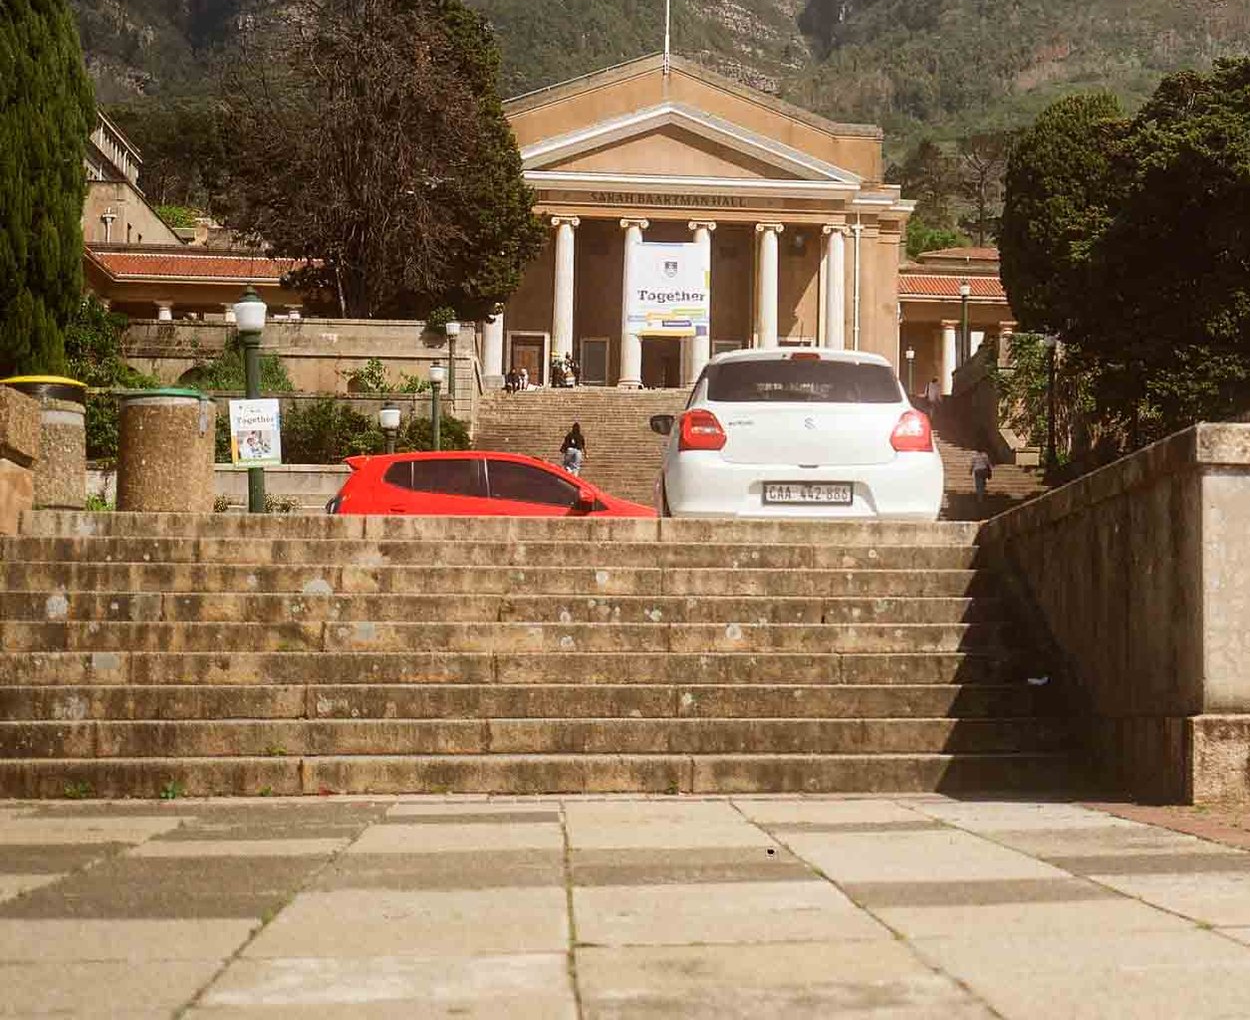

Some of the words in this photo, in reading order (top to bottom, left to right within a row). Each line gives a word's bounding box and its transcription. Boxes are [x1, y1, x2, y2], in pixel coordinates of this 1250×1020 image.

[712, 196, 746, 207] HALL
[637, 289, 706, 304] Together
[769, 485, 792, 500] CAA
